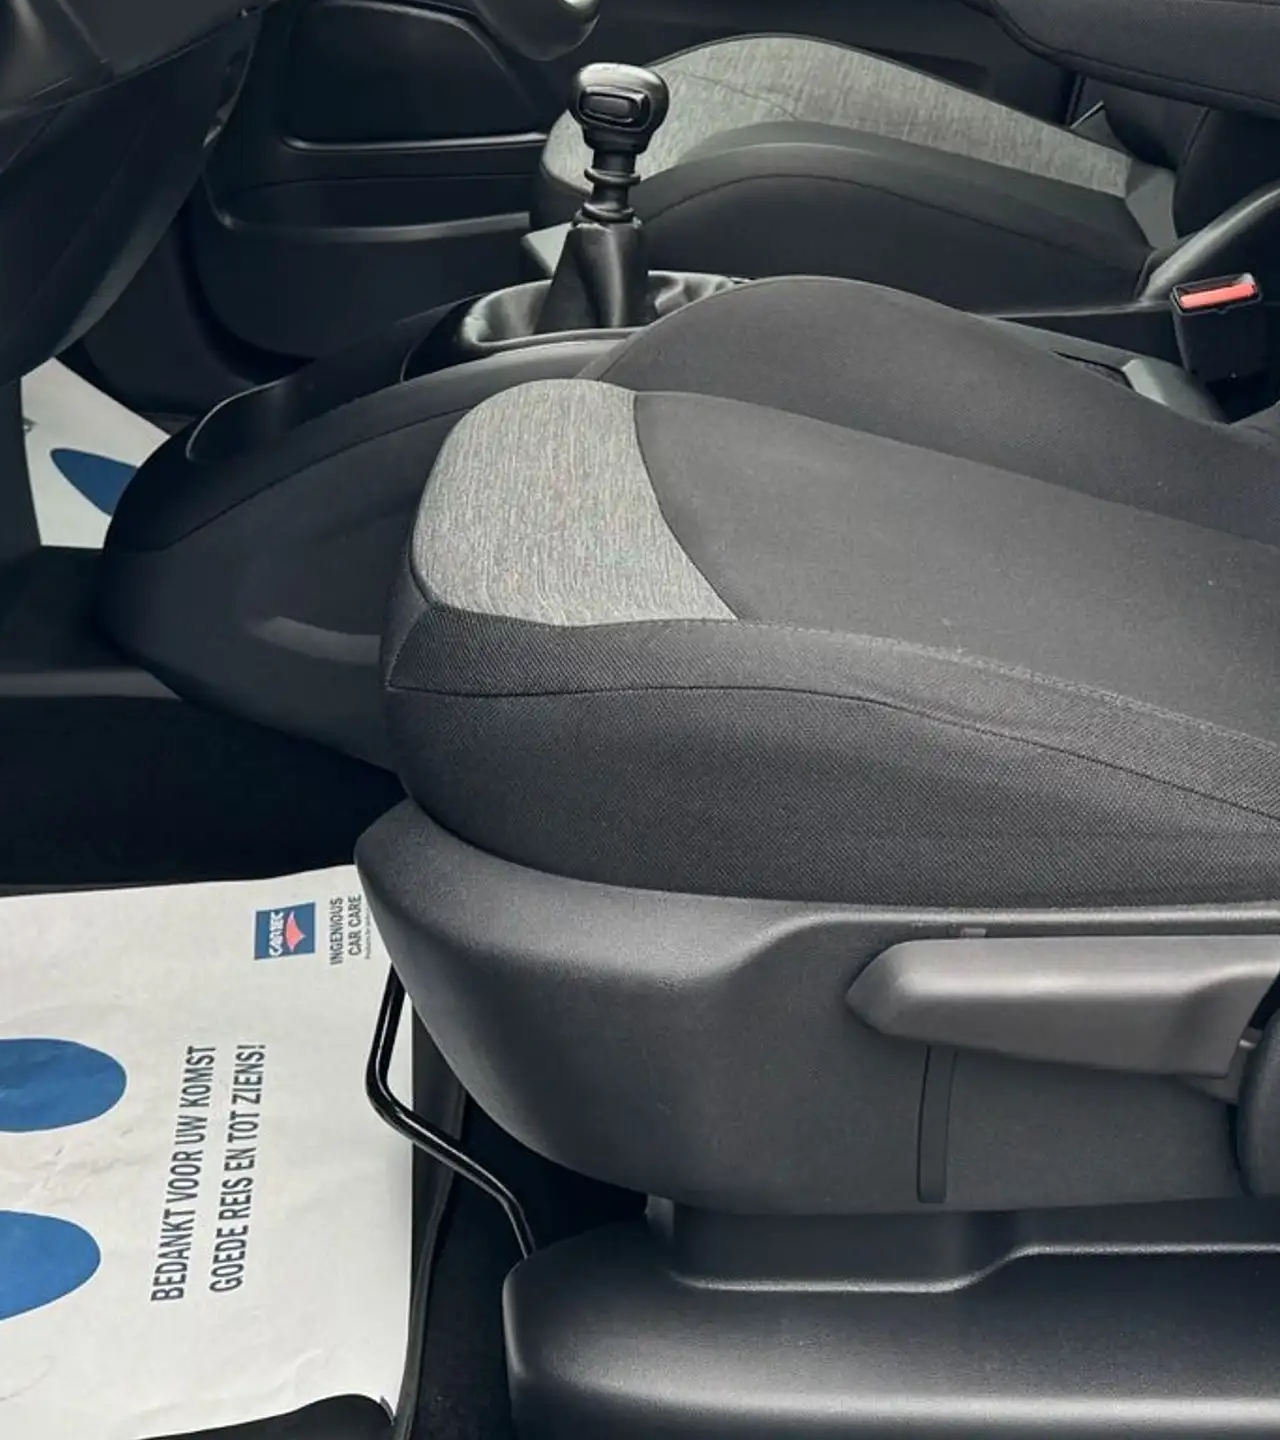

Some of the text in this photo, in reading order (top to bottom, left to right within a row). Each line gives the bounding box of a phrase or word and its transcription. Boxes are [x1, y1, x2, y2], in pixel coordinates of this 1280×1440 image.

[329, 897, 344, 966] INGENIOUS
[347, 894, 362, 956] CAR CARE
[150, 1045, 217, 1302] BEDANKT VOOR UW KOMST
[208, 1044, 266, 1293] GOEDE REIS EN TOT ZIENS!
